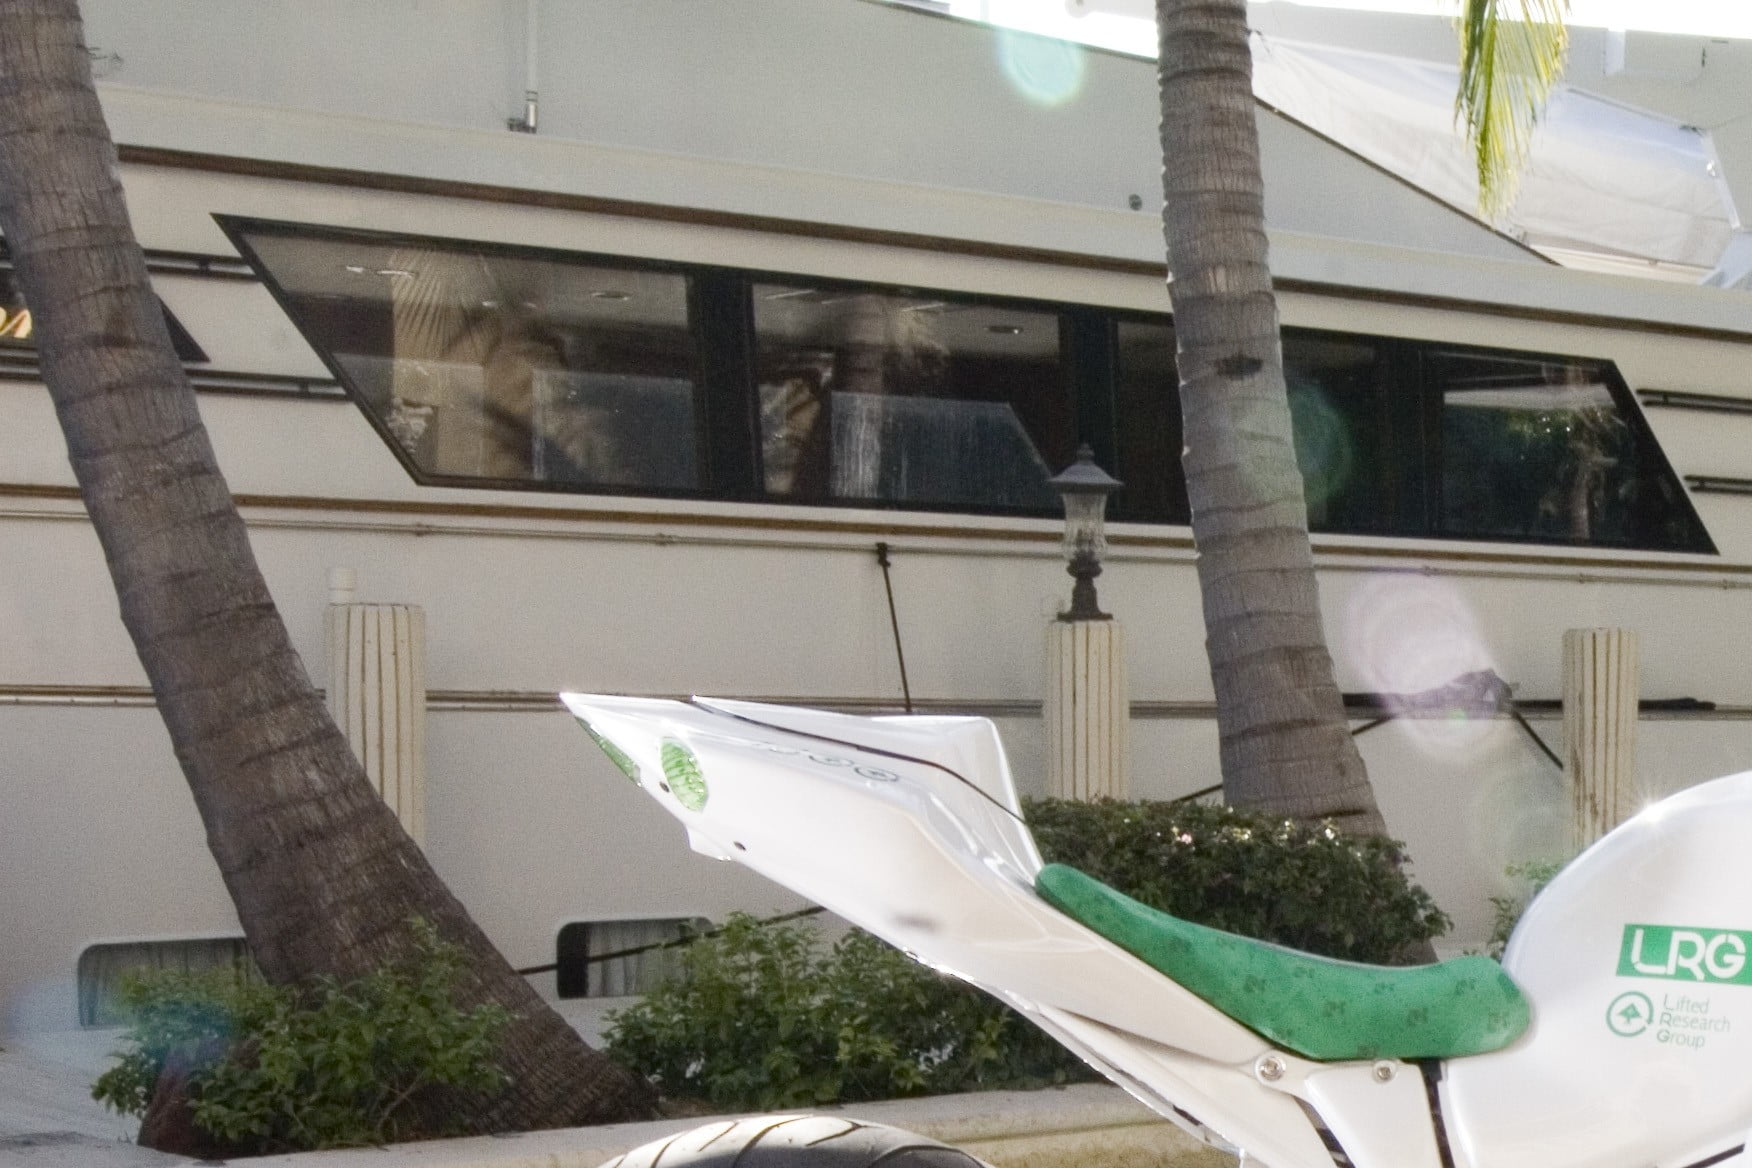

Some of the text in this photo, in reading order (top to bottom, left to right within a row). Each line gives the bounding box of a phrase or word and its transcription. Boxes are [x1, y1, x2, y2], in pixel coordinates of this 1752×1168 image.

[1630, 928, 1746, 982] LRG
[1662, 993, 1710, 1014] Lifted
[1659, 1012, 1731, 1032] Research
[1656, 1029, 1706, 1051] Group
